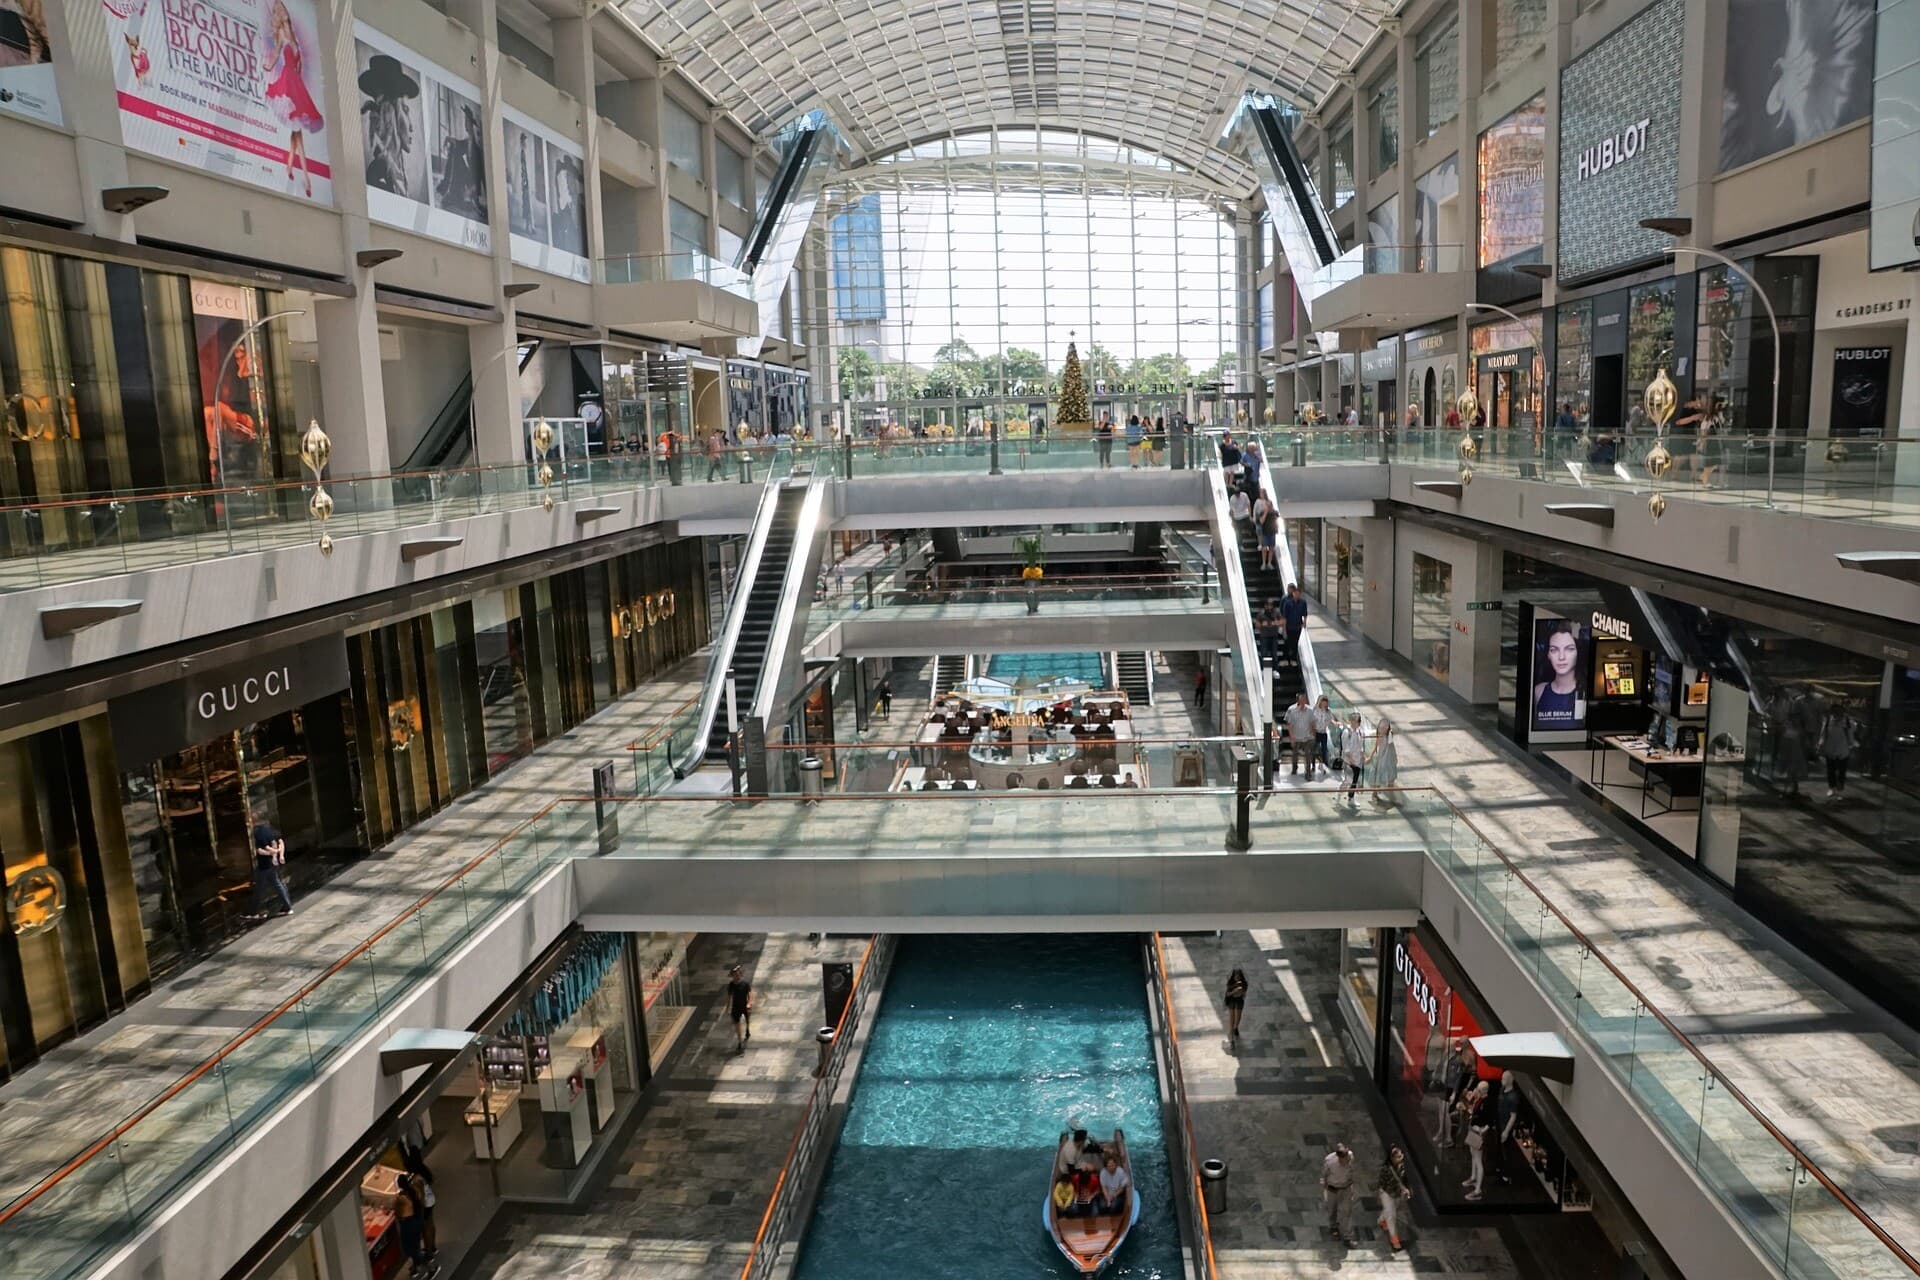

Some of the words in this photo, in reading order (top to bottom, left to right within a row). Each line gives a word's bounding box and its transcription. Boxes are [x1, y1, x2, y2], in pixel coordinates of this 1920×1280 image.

[167, 0, 257, 54] LEGALLY
[168, 17, 260, 82] BLONDE
[171, 48, 201, 74] THE
[204, 62, 263, 100] MUSICAL
[1578, 117, 1650, 181] HUBLOT
[195, 294, 239, 311] GUCCI
[1844, 301, 1893, 318] GARDENS
[1899, 298, 1911, 311] BY
[1835, 348, 1890, 360] HUBLOT
[1592, 611, 1632, 641] CHANEL
[198, 667, 290, 719] GUCCI
[1396, 943, 1436, 1027] GUESS
